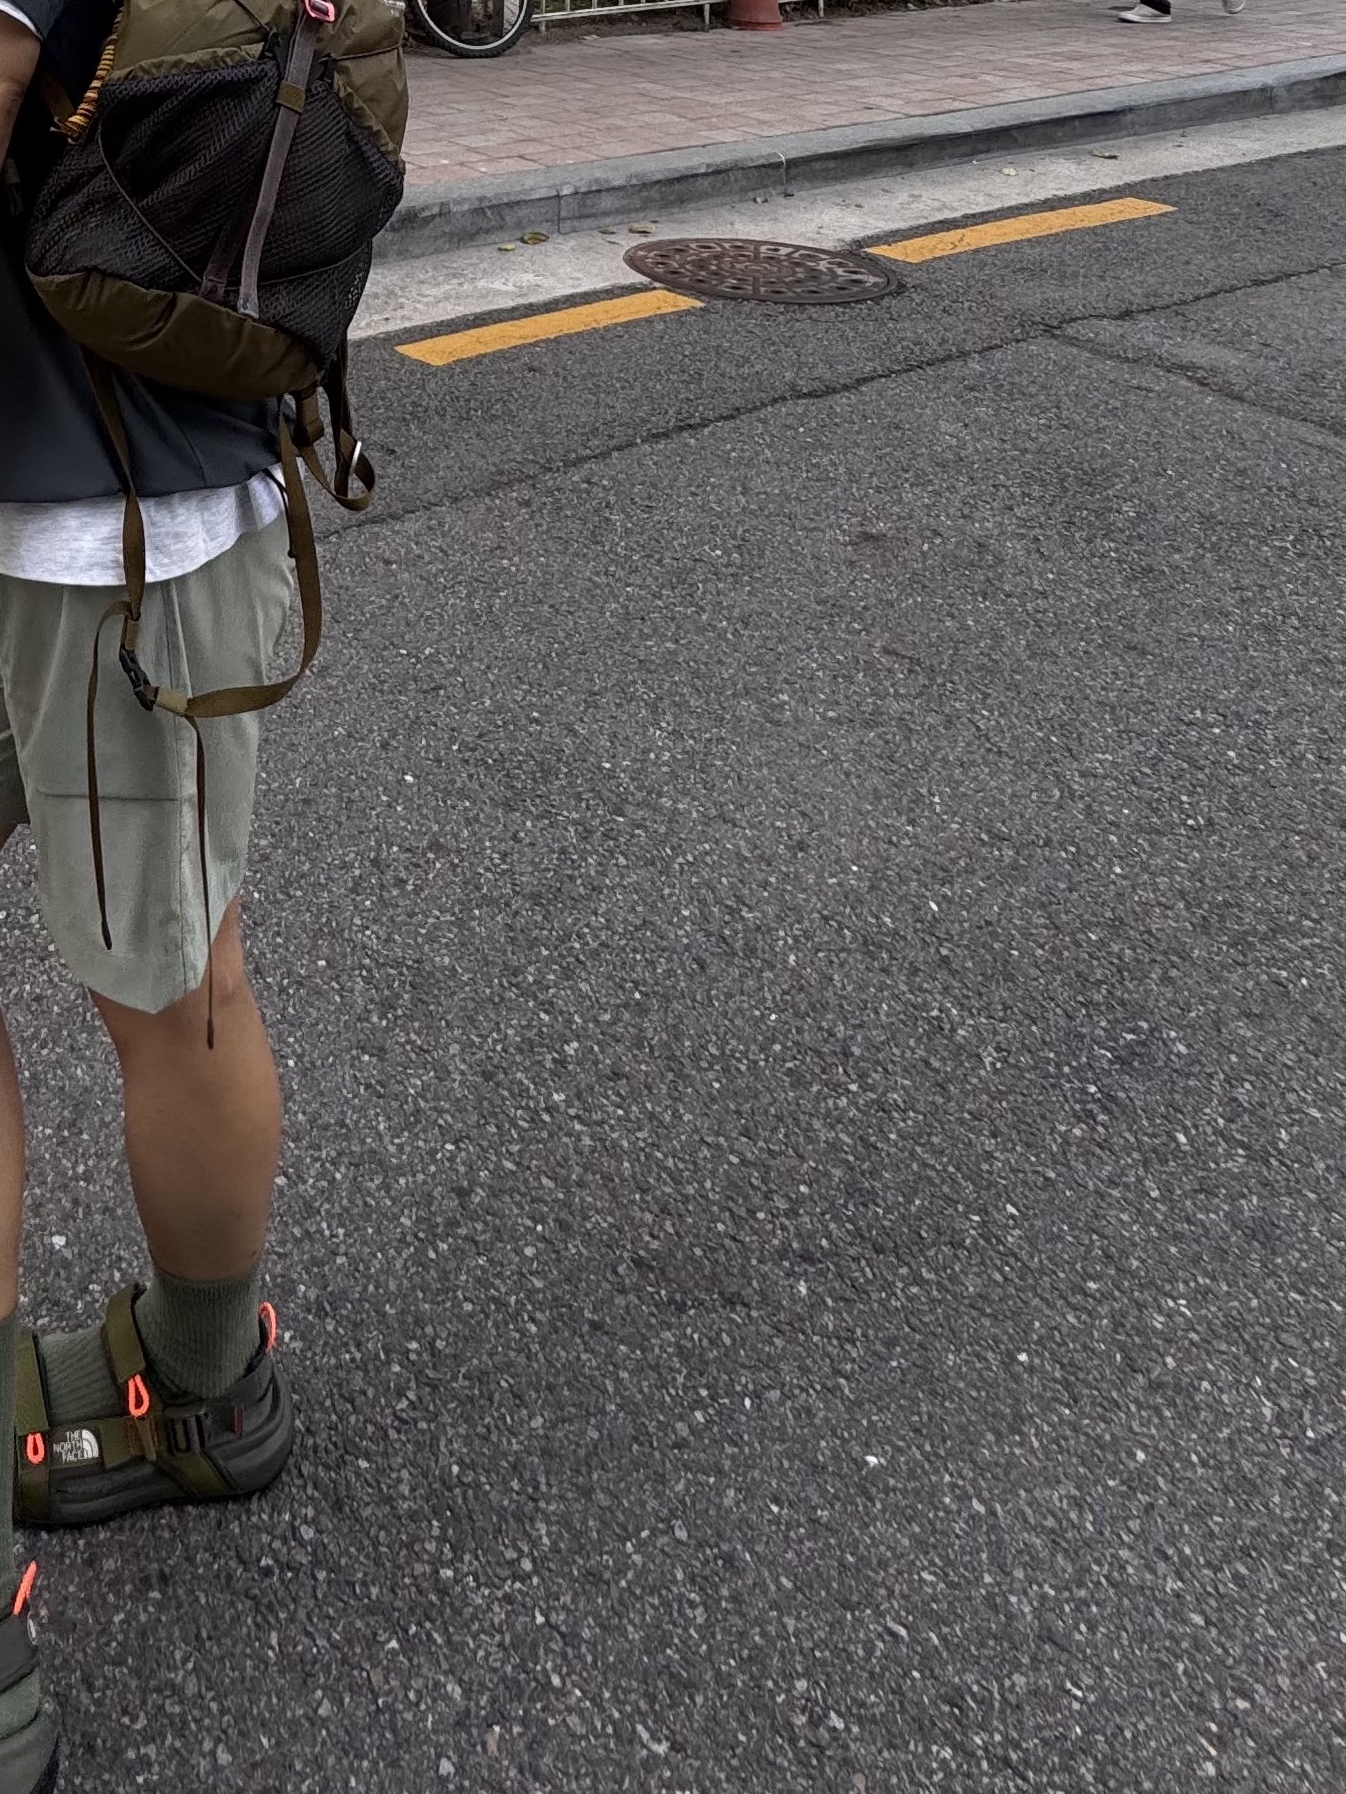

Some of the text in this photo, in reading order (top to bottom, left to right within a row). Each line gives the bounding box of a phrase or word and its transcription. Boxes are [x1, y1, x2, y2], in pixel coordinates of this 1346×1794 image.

[65, 1429, 81, 1442] THE
[52, 1437, 83, 1454] NORTH
[62, 1450, 84, 1463] FACE
